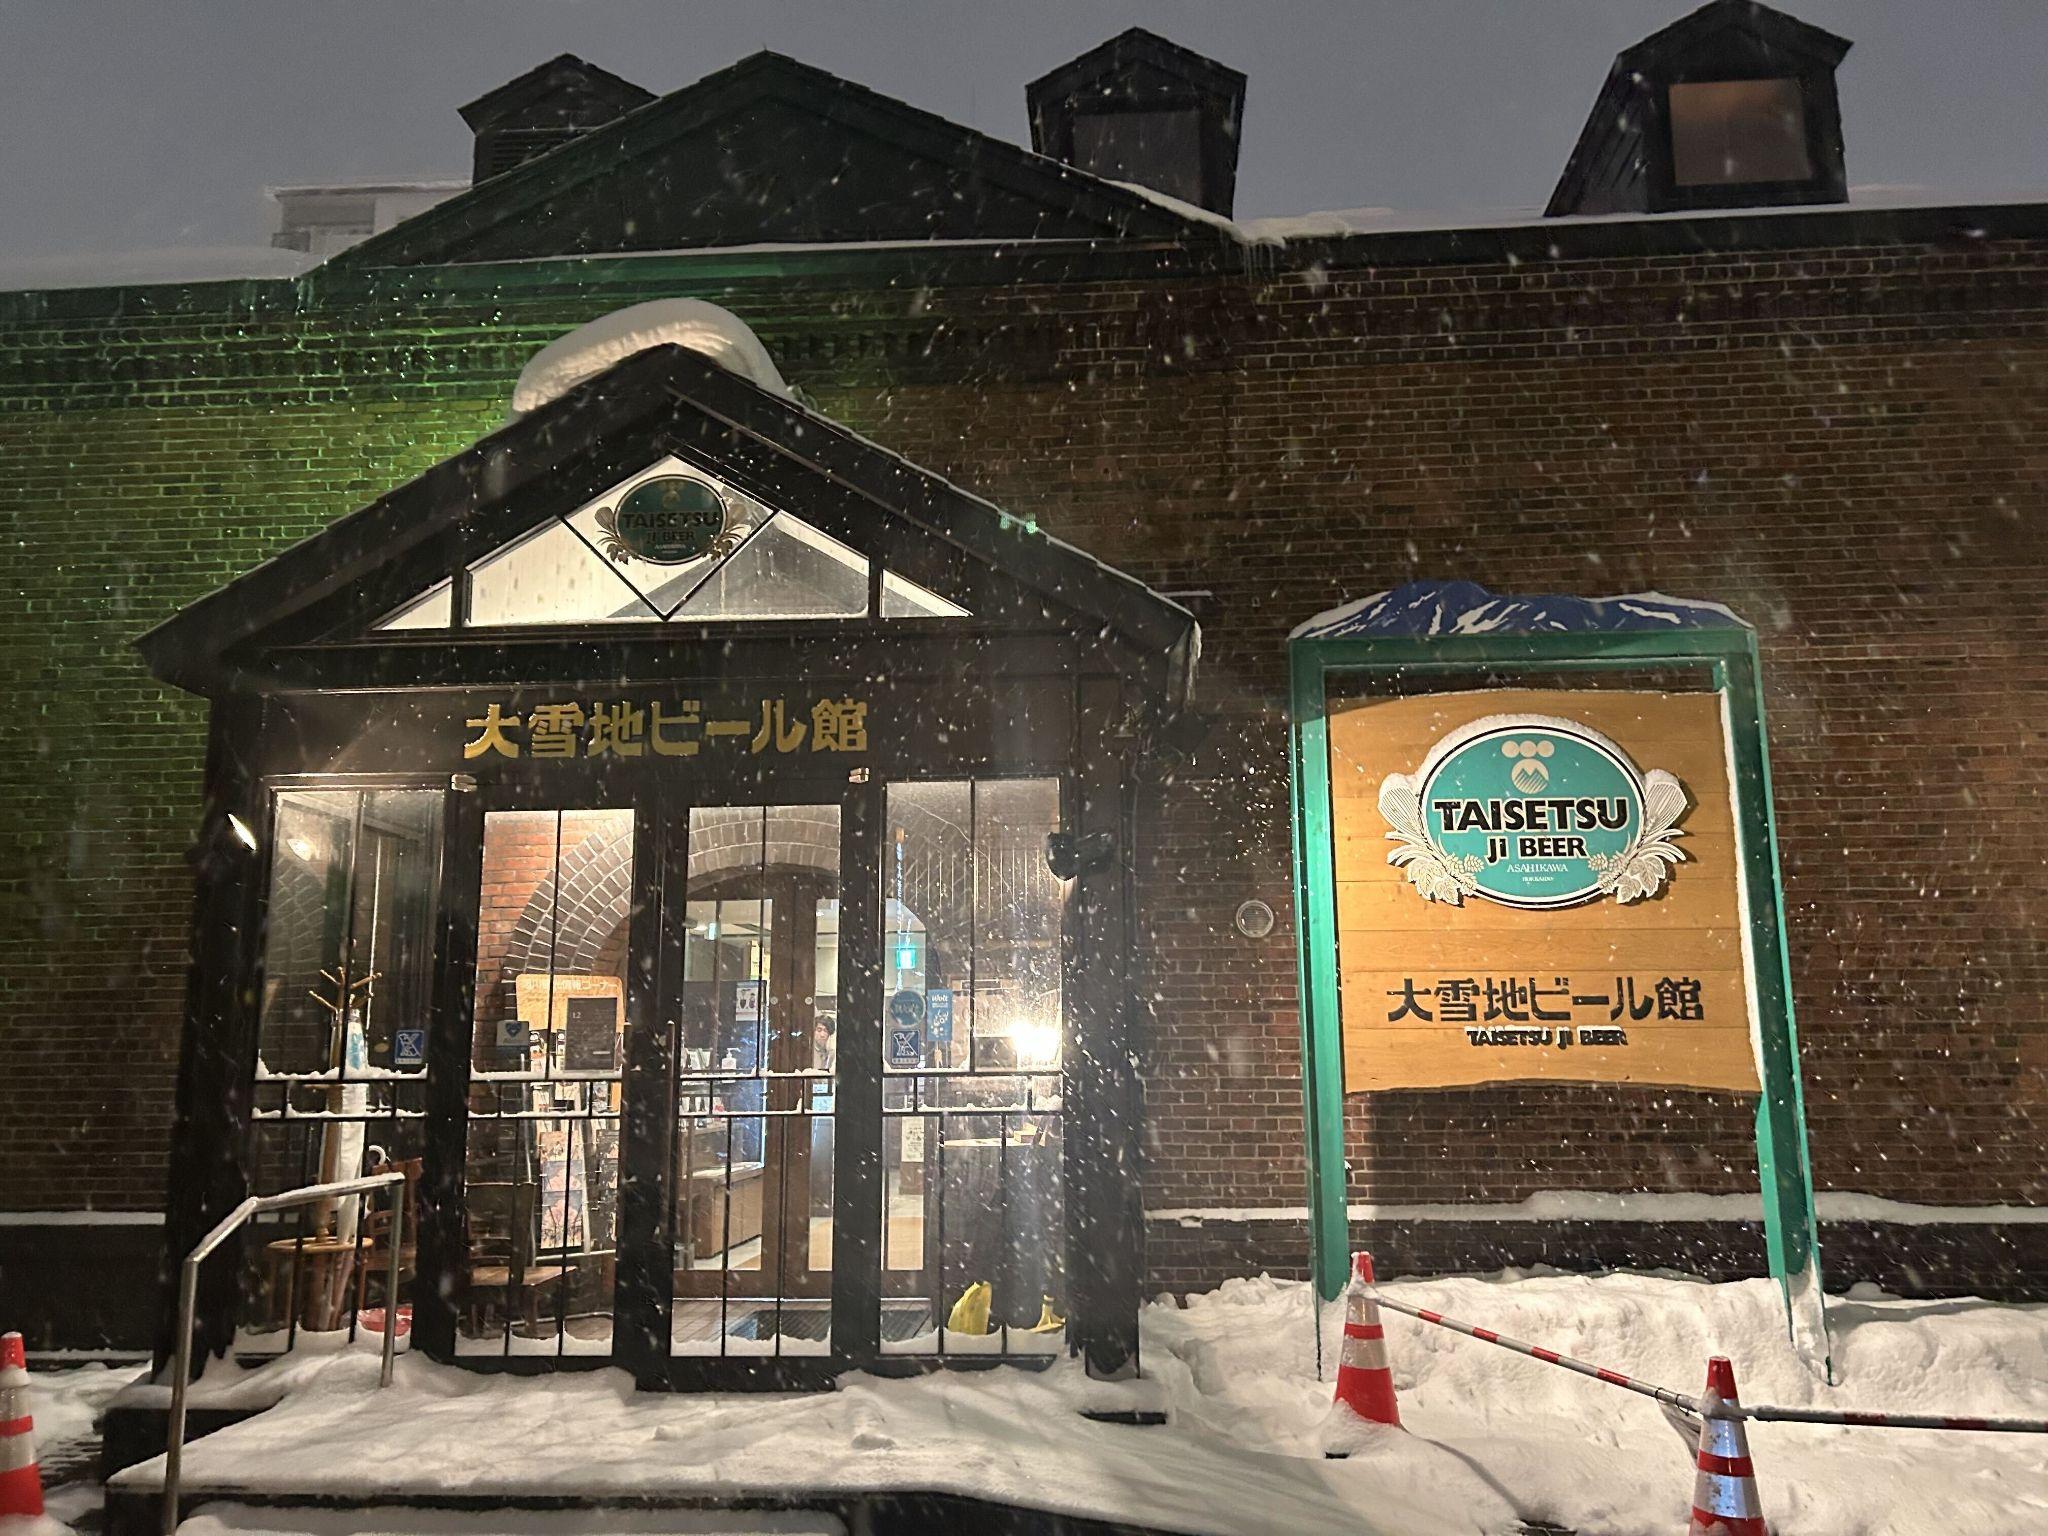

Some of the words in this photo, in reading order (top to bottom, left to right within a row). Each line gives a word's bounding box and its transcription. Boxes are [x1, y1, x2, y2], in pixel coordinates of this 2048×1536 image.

[622, 512, 718, 529] TAISETSU
[663, 531, 695, 542] BEER
[463, 699, 868, 758] 大雪地ビール館
[1434, 799, 1628, 831] TAISETSU
[1519, 838, 1588, 857] BEER
[1507, 864, 1568, 872] ASAHIKAWA
[1387, 977, 1704, 1022] 大雪地ビール館
[1467, 1029, 1553, 1046] TAISETSU
[1580, 1029, 1628, 1046] BEER
